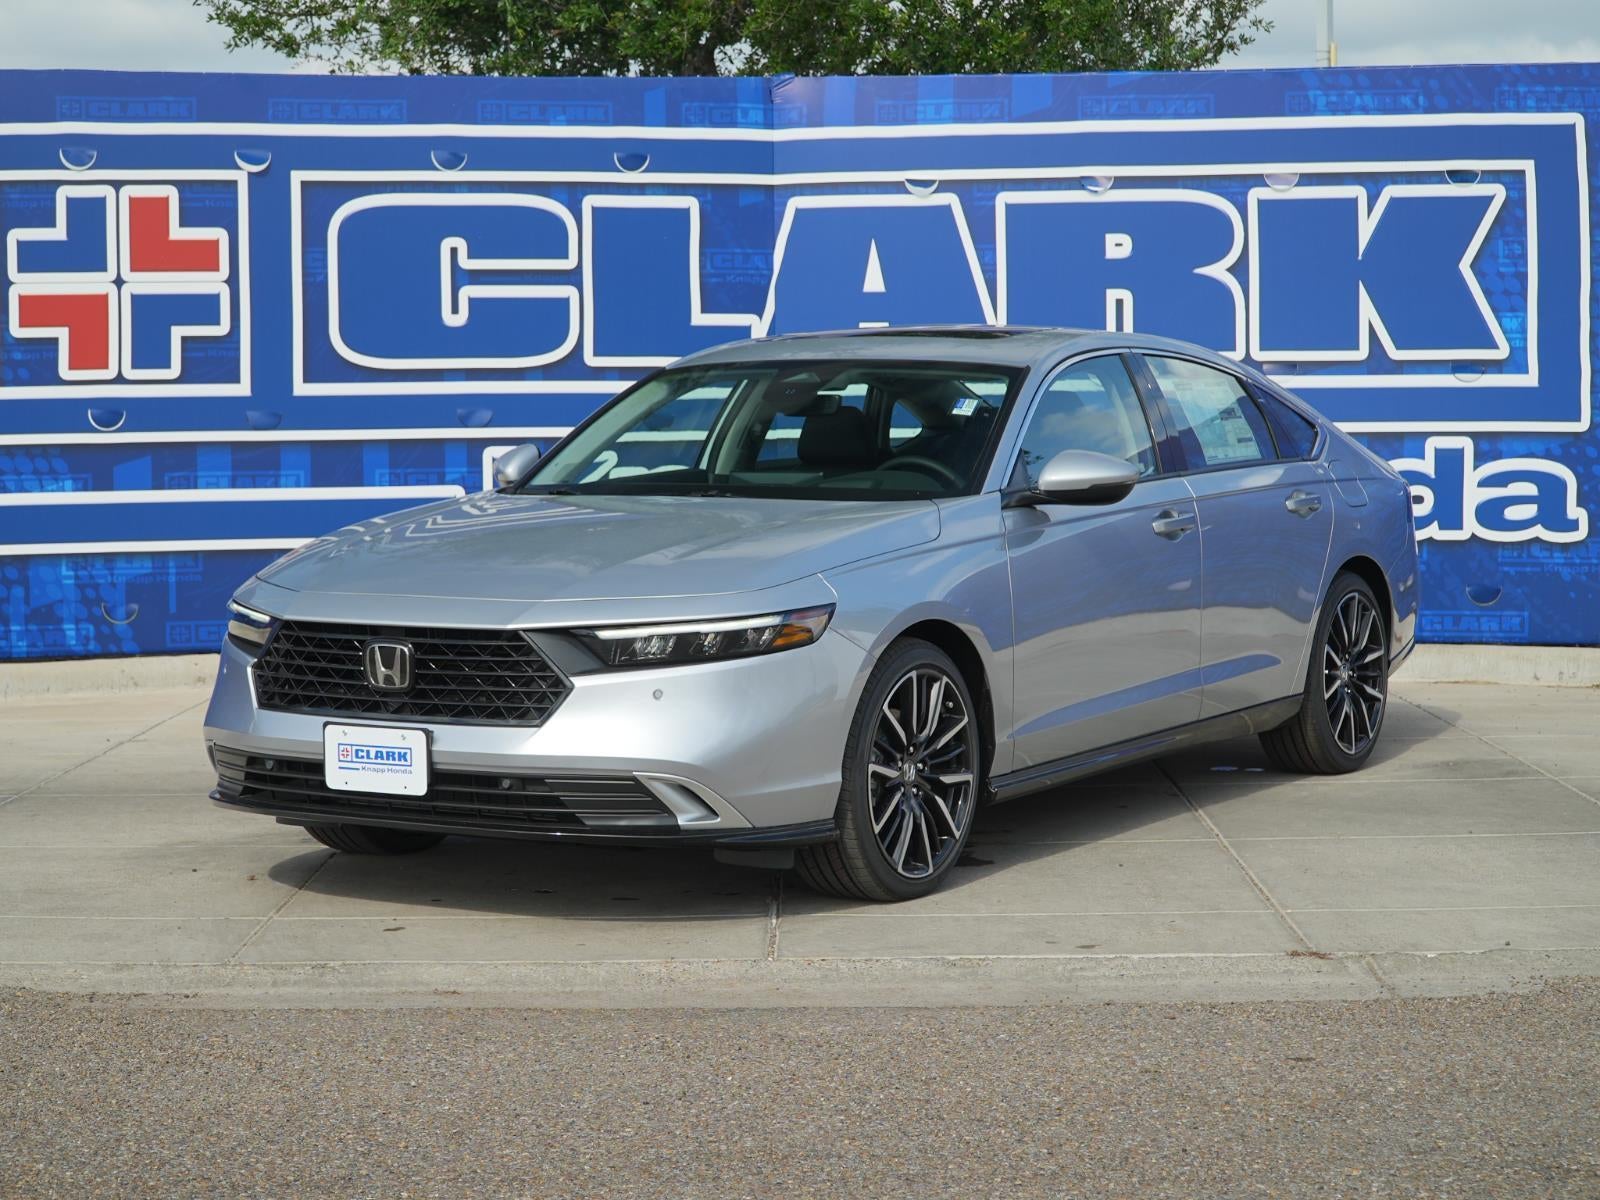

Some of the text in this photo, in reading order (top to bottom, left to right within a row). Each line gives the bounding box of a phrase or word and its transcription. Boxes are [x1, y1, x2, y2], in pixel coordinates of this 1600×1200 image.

[88, 101, 192, 118] CLARK
[299, 103, 402, 121] CLARK
[507, 104, 608, 122] CLARK
[904, 103, 1001, 121] CLARK
[1106, 98, 1209, 114] CLARK
[326, 182, 1510, 370] CLARK
[1421, 615, 1521, 632] CLARK
[354, 748, 408, 763] CLARK
[361, 765, 413, 775] Knapp Honda
